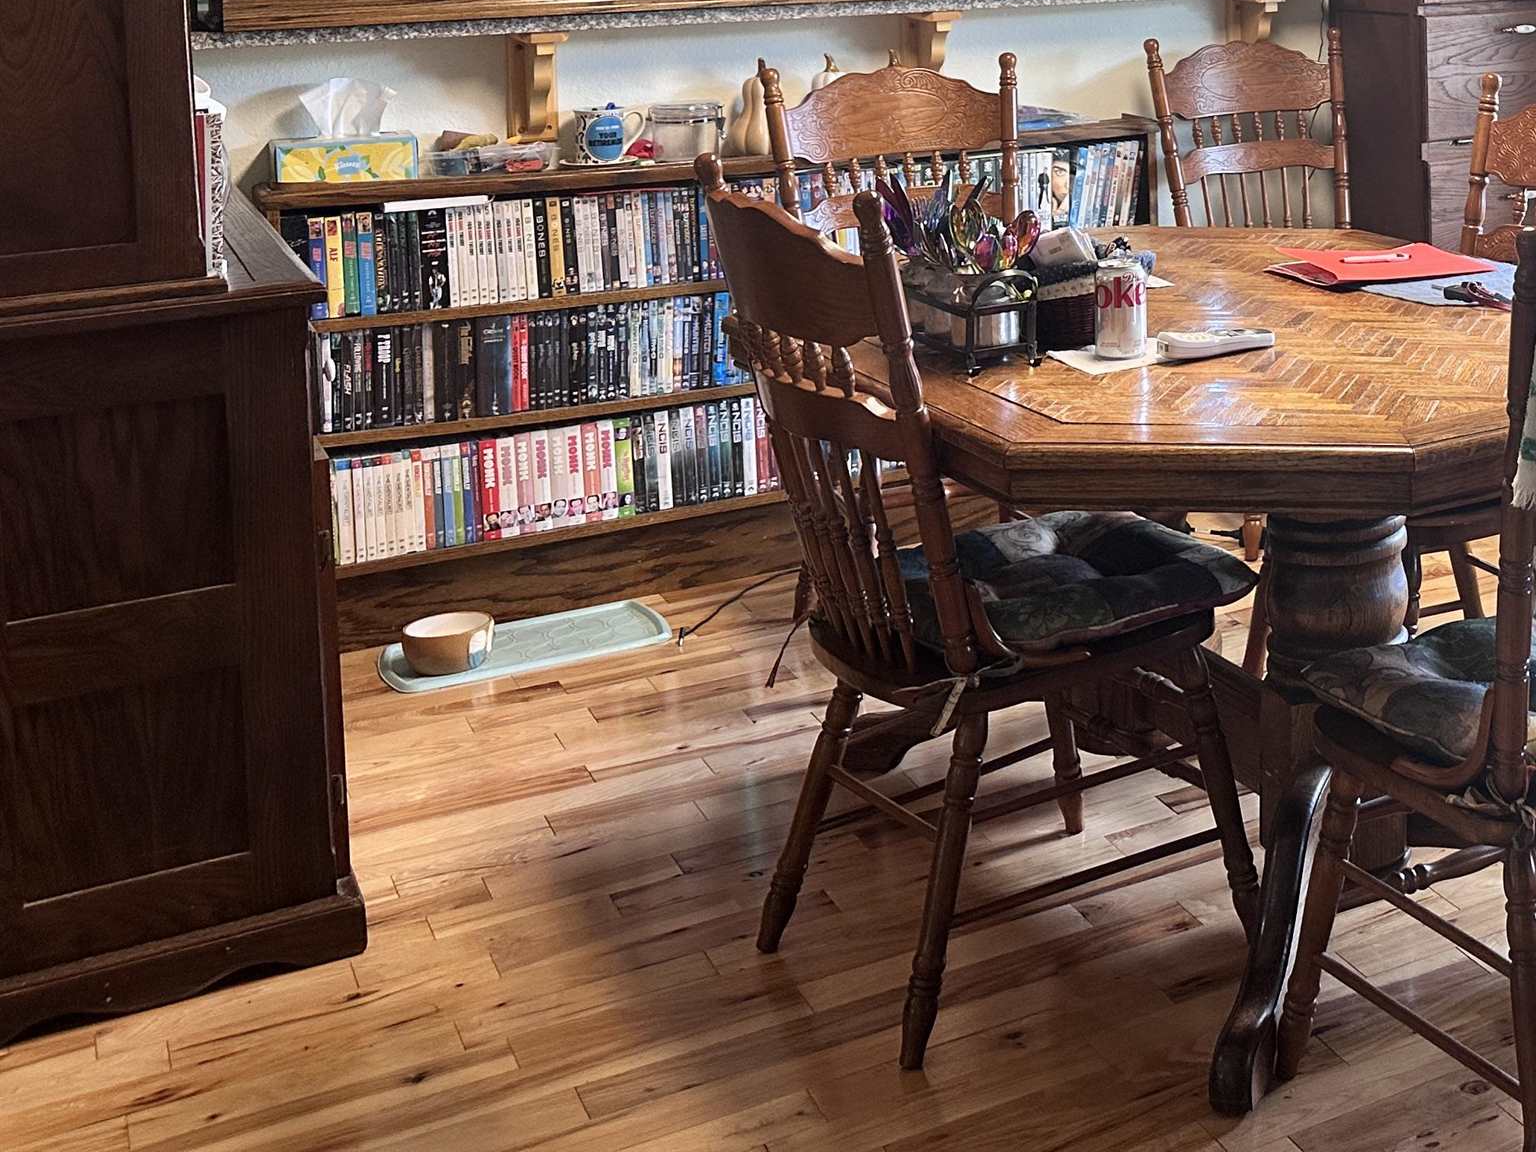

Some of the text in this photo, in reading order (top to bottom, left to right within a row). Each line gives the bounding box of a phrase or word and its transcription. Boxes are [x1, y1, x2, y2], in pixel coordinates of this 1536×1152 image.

[536, 216, 546, 257] BONES
[344, 364, 352, 395] FLASH
[567, 435, 579, 475] MONK
[585, 431, 596, 472] MONK
[601, 429, 612, 469] MONK
[658, 423, 668, 454] NCIS
[483, 448, 495, 488] MONK
[518, 441, 529, 481] MONK
